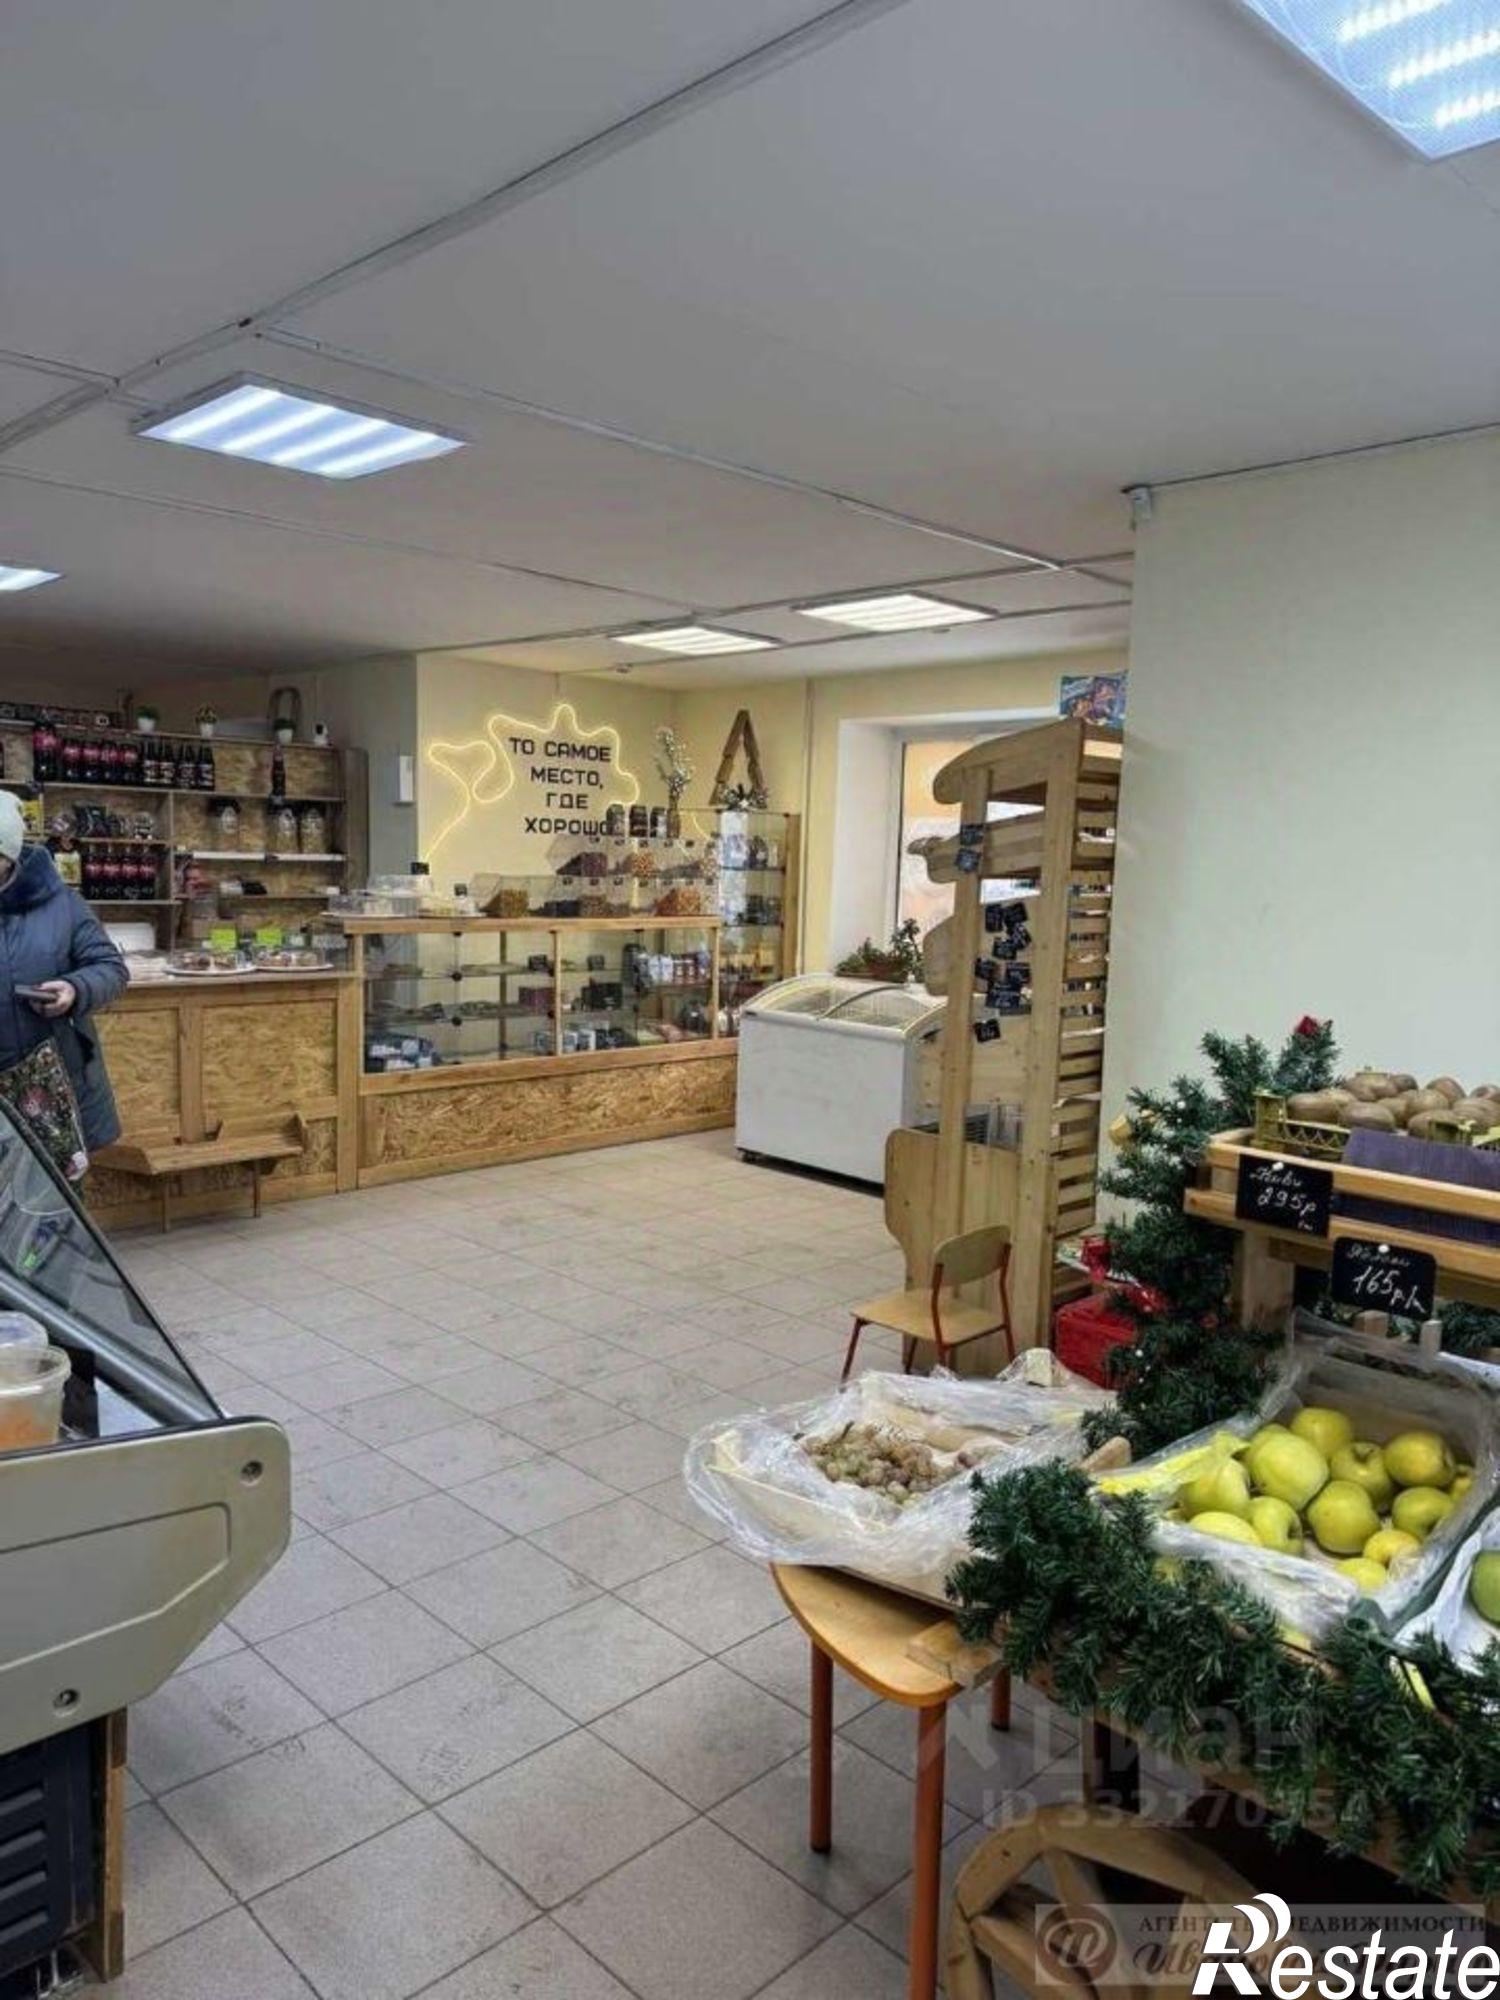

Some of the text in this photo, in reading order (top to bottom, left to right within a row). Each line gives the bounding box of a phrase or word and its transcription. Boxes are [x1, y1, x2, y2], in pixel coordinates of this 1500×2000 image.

[509, 737, 612, 763] ТО САМОЕ
[530, 766, 604, 790] МЕСТО,
[546, 792, 589, 809] ГДЕ
